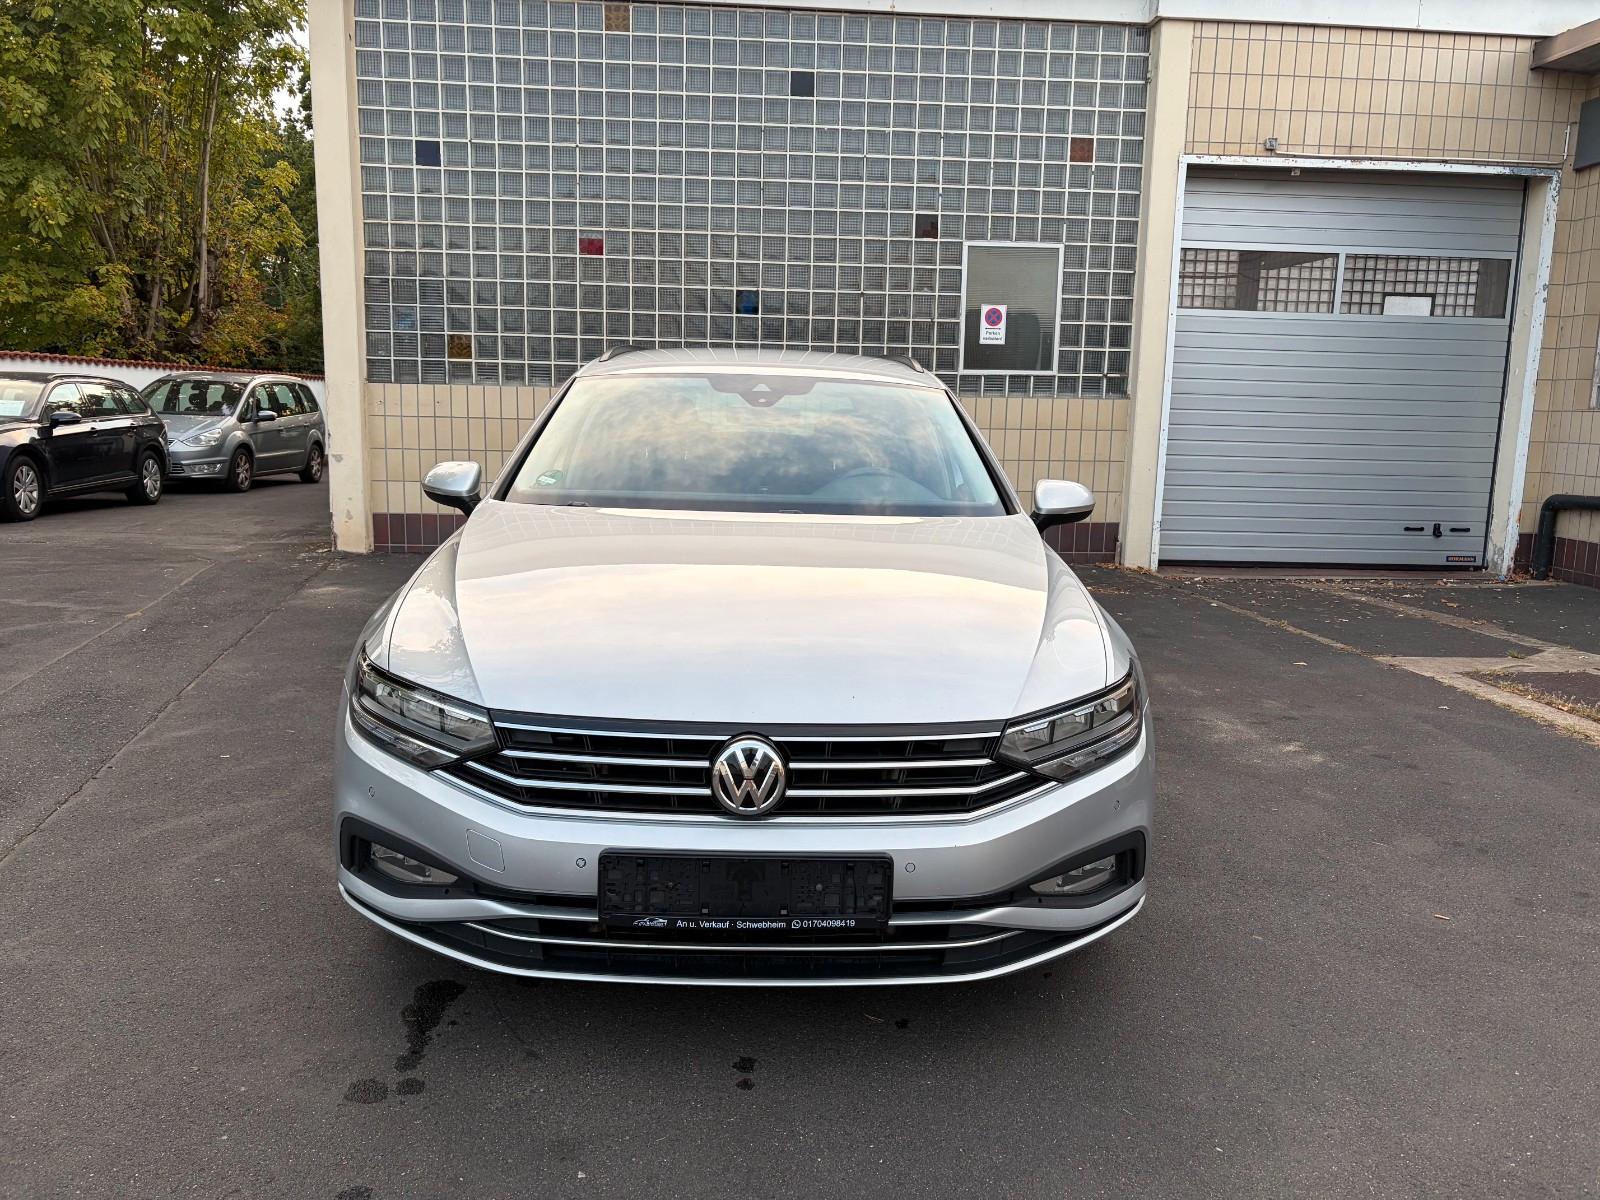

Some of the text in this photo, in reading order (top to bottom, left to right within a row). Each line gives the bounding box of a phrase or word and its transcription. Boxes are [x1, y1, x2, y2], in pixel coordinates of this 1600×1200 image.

[714, 741, 783, 813] VW
[676, 919, 687, 928] An
[699, 920, 729, 929] Verkauf
[736, 920, 786, 929] Schwebheim
[803, 919, 856, 928] 01704098419
